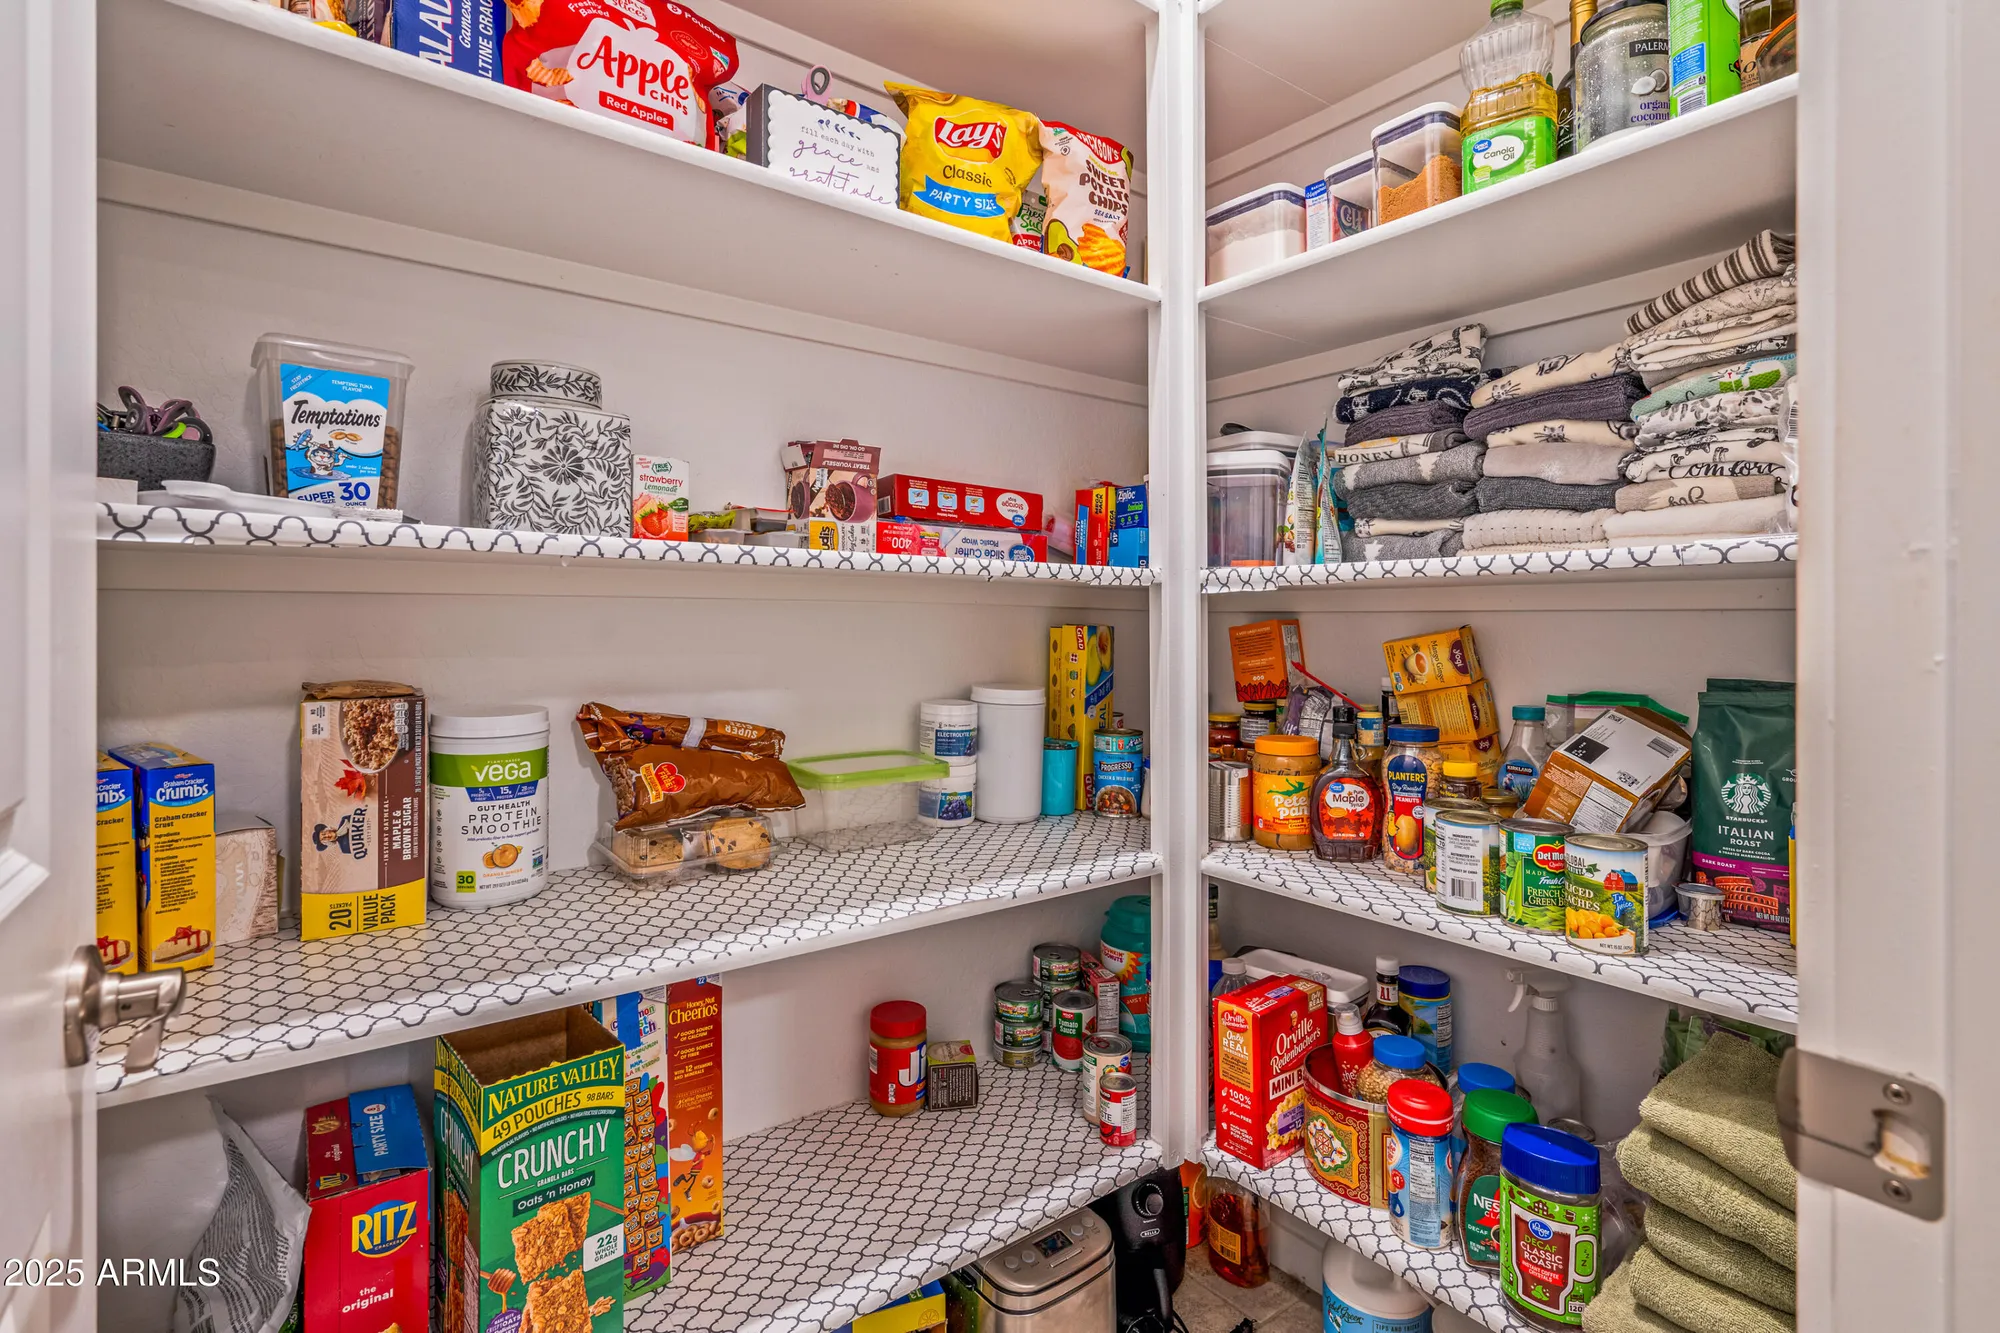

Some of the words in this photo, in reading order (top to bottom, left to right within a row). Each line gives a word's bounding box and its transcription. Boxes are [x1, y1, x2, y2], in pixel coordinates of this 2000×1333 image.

[579, 8, 610, 18] Baked
[684, 12, 726, 43] Pouches
[577, 35, 689, 100] Apple
[606, 96, 628, 111] Red
[630, 104, 669, 125] Apples
[650, 89, 689, 116] CHIPS
[801, 126, 818, 138] fill
[820, 134, 839, 145] each
[938, 121, 1003, 149] Lay's
[793, 140, 863, 167] grace
[1076, 130, 1120, 163] JACKSON'S
[1483, 146, 1515, 160] Canola
[1502, 153, 1515, 161] Oil
[943, 164, 993, 188] Classic
[1085, 159, 1126, 190] SWEET
[929, 188, 972, 208] PARTY
[974, 197, 997, 211] SIZE
[1088, 190, 1128, 217] CHIPS
[1104, 212, 1121, 222] SALT
[331, 379, 358, 388] TEMPTING
[291, 400, 381, 429] Temptations
[822, 460, 851, 468] YOURSELF
[1337, 450, 1394, 463] HONEY
[639, 473, 683, 487] strawberry
[644, 482, 678, 493] Lemonade
[338, 482, 371, 501] 30
[1001, 500, 1024, 511] Storage
[891, 537, 912, 549] 400
[962, 537, 979, 546] Wrap
[980, 539, 999, 548] Plastic
[955, 546, 982, 558] Cutter
[983, 549, 1005, 560] Slide
[1075, 626, 1085, 650] GLAD
[1430, 640, 1440, 661] Mango
[1436, 661, 1445, 683] Ginger
[725, 724, 758, 739] SUPER
[470, 761, 532, 782] vega
[1101, 762, 1132, 771] PROGRESSO
[1388, 770, 1426, 783] PLANTERS
[155, 783, 209, 802] Crumbs
[1085, 775, 1094, 808] GLAD
[1401, 784, 1422, 792] Roasted
[477, 804, 496, 812] GUT
[498, 799, 531, 811] HEALTH
[1332, 794, 1365, 804] Maple
[1395, 796, 1420, 804] PEANUTS
[154, 814, 181, 823] Graham
[181, 811, 208, 820] Cracker
[402, 797, 411, 827] SUGAR
[468, 806, 538, 824] PROTEIN
[1725, 815, 1766, 824] STARBUCKS
[154, 821, 174, 829] Crust
[461, 816, 542, 835] SMOOTHIE
[1718, 825, 1775, 841] ITALIAN
[352, 807, 368, 860] QUAKER
[393, 819, 401, 850] MAPLE
[403, 828, 411, 860] BROWN
[1730, 838, 1761, 848] ROAST
[1537, 851, 1551, 860] Del
[1702, 858, 1716, 866] DARK
[1716, 860, 1737, 869] ROAST
[1740, 852, 1776, 861] MARSHMALLOW
[457, 875, 474, 884] 30
[1525, 869, 1547, 877] MADE
[1539, 875, 1558, 885] Fresh
[1527, 886, 1561, 898] FRENCH
[1613, 893, 1621, 903] In
[1528, 895, 1558, 906] GREEN
[362, 894, 378, 931] VALUE
[380, 894, 396, 925] PACK
[1616, 901, 1633, 918] Juice
[329, 909, 352, 931] 20
[686, 1000, 705, 1009] Honey
[704, 996, 716, 1005] Nut
[669, 1003, 718, 1025] Cheerios
[1224, 1012, 1246, 1025] Orville
[696, 1025, 714, 1033] SOURCE
[1058, 1018, 1079, 1028] Tomato
[1059, 1025, 1077, 1035] Sauce
[1226, 1031, 1244, 1044] Only
[1276, 1017, 1313, 1055] Orville
[696, 1042, 714, 1051] SOURCE
[1222, 1039, 1249, 1056] REAL
[1270, 1027, 1322, 1077] Redenbacher's
[684, 1069, 705, 1078] MINERALS
[685, 1064, 693, 1072] 12
[488, 1073, 559, 1122] NATURE
[561, 1054, 621, 1086] VALLEY
[1271, 1077, 1297, 1096] MINI
[1229, 1089, 1252, 1105] 100%
[371, 1113, 384, 1133] SIZE
[493, 1121, 511, 1140] 49
[513, 1091, 581, 1130] POUCHES
[586, 1093, 595, 1102] 98
[596, 1091, 614, 1101] BARS
[373, 1134, 388, 1158] PARTY
[440, 1107, 475, 1184] CRUNCHY
[1230, 1131, 1253, 1146] POPCORN
[330, 1143, 340, 1162] original
[497, 1118, 611, 1189] CRUNCHY
[1410, 1153, 1425, 1161] Calories
[319, 1172, 346, 1191] RITZ
[536, 1173, 560, 1187] GRANOLA
[561, 1167, 575, 1179] BARS
[517, 1194, 544, 1211] Oats
[545, 1189, 556, 1199] 'n
[559, 1175, 593, 1193] Honey
[351, 1200, 418, 1254] RITZ
[1467, 1223, 1488, 1235] DECAF
[1531, 1221, 1551, 1237] Kroger
[374, 1239, 403, 1251] CRACKERS
[594, 1242, 618, 1256] WHOLE
[597, 1233, 618, 1249] 22g
[1524, 1234, 1558, 1252] DECAF
[1520, 1241, 1563, 1264] CLASSIC
[1524, 1250, 1560, 1270] ROAST
[1521, 1260, 1541, 1274] INSTANT
[1541, 1268, 1560, 1280] COFFEE
[1528, 1269, 1553, 1283] CRYSTALS
[359, 1285, 377, 1297] the
[342, 1288, 394, 1314] original
[1569, 1304, 1582, 1313] 120
[1375, 1323, 1389, 1332] TIPS
